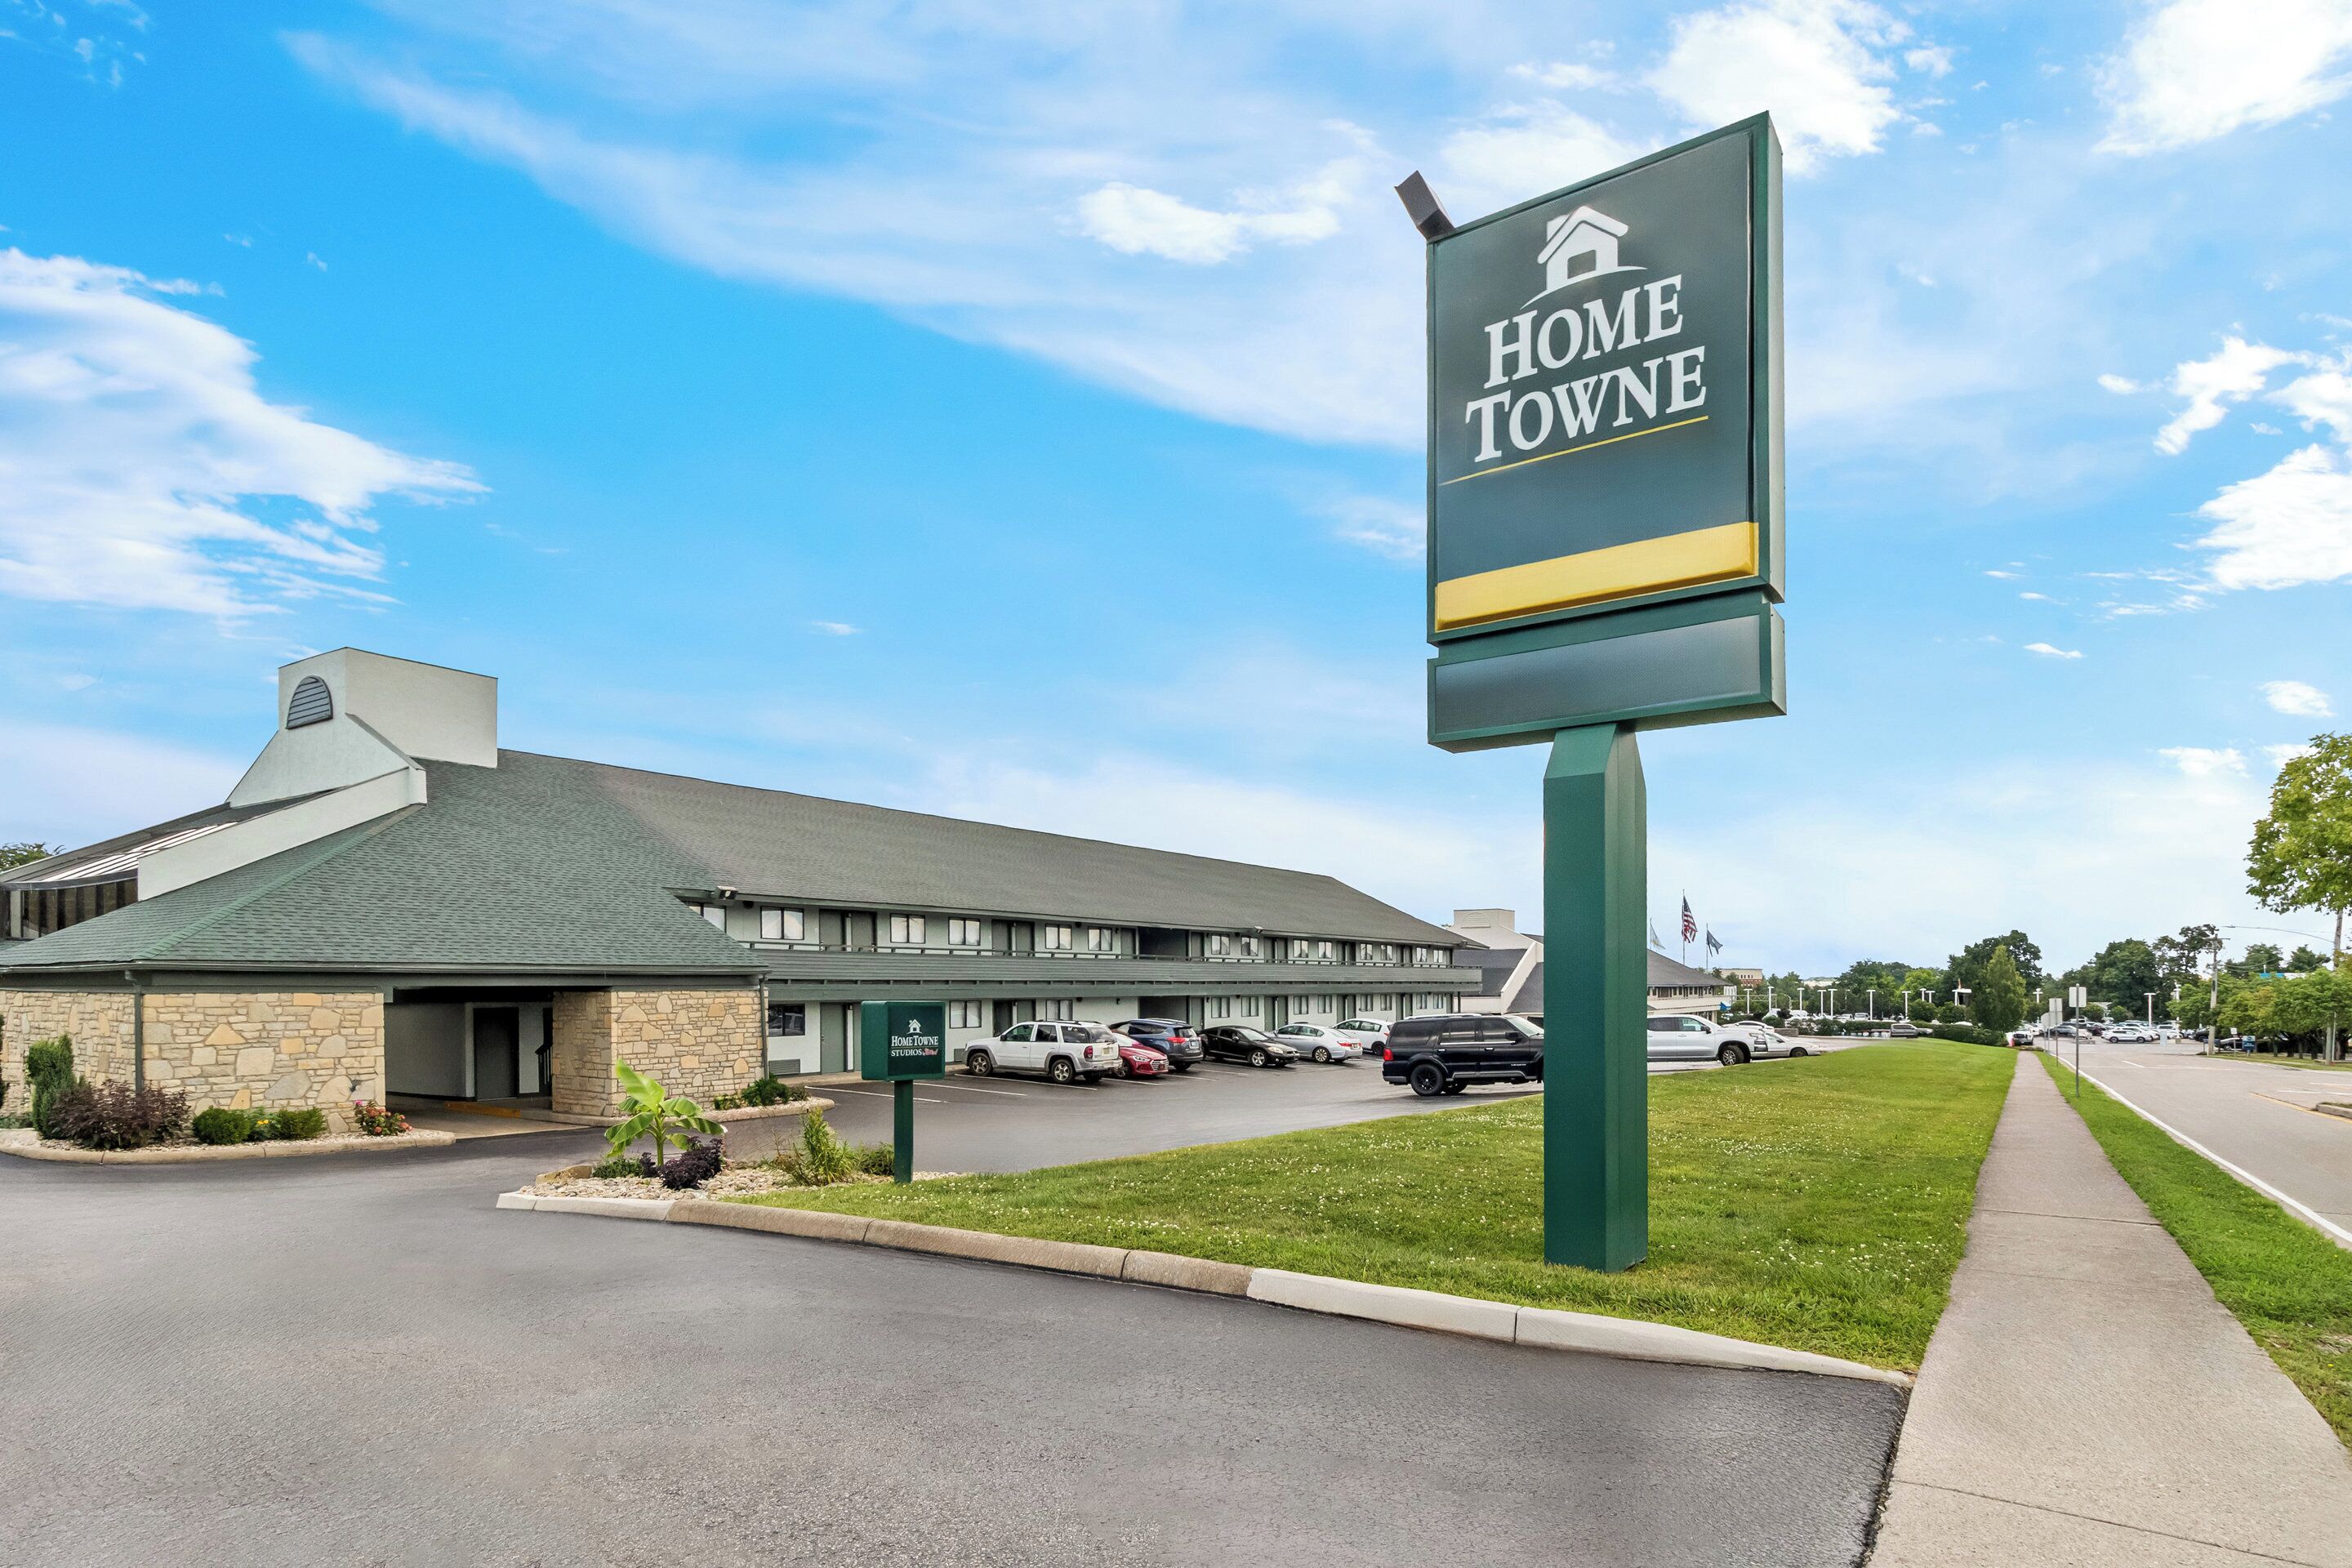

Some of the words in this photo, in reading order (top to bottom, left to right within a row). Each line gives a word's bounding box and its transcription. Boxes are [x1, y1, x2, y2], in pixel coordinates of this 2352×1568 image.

[1484, 274, 1683, 390] HOME
[1465, 345, 1707, 463] TOWNE
[891, 1049, 922, 1057] STUDIOS
